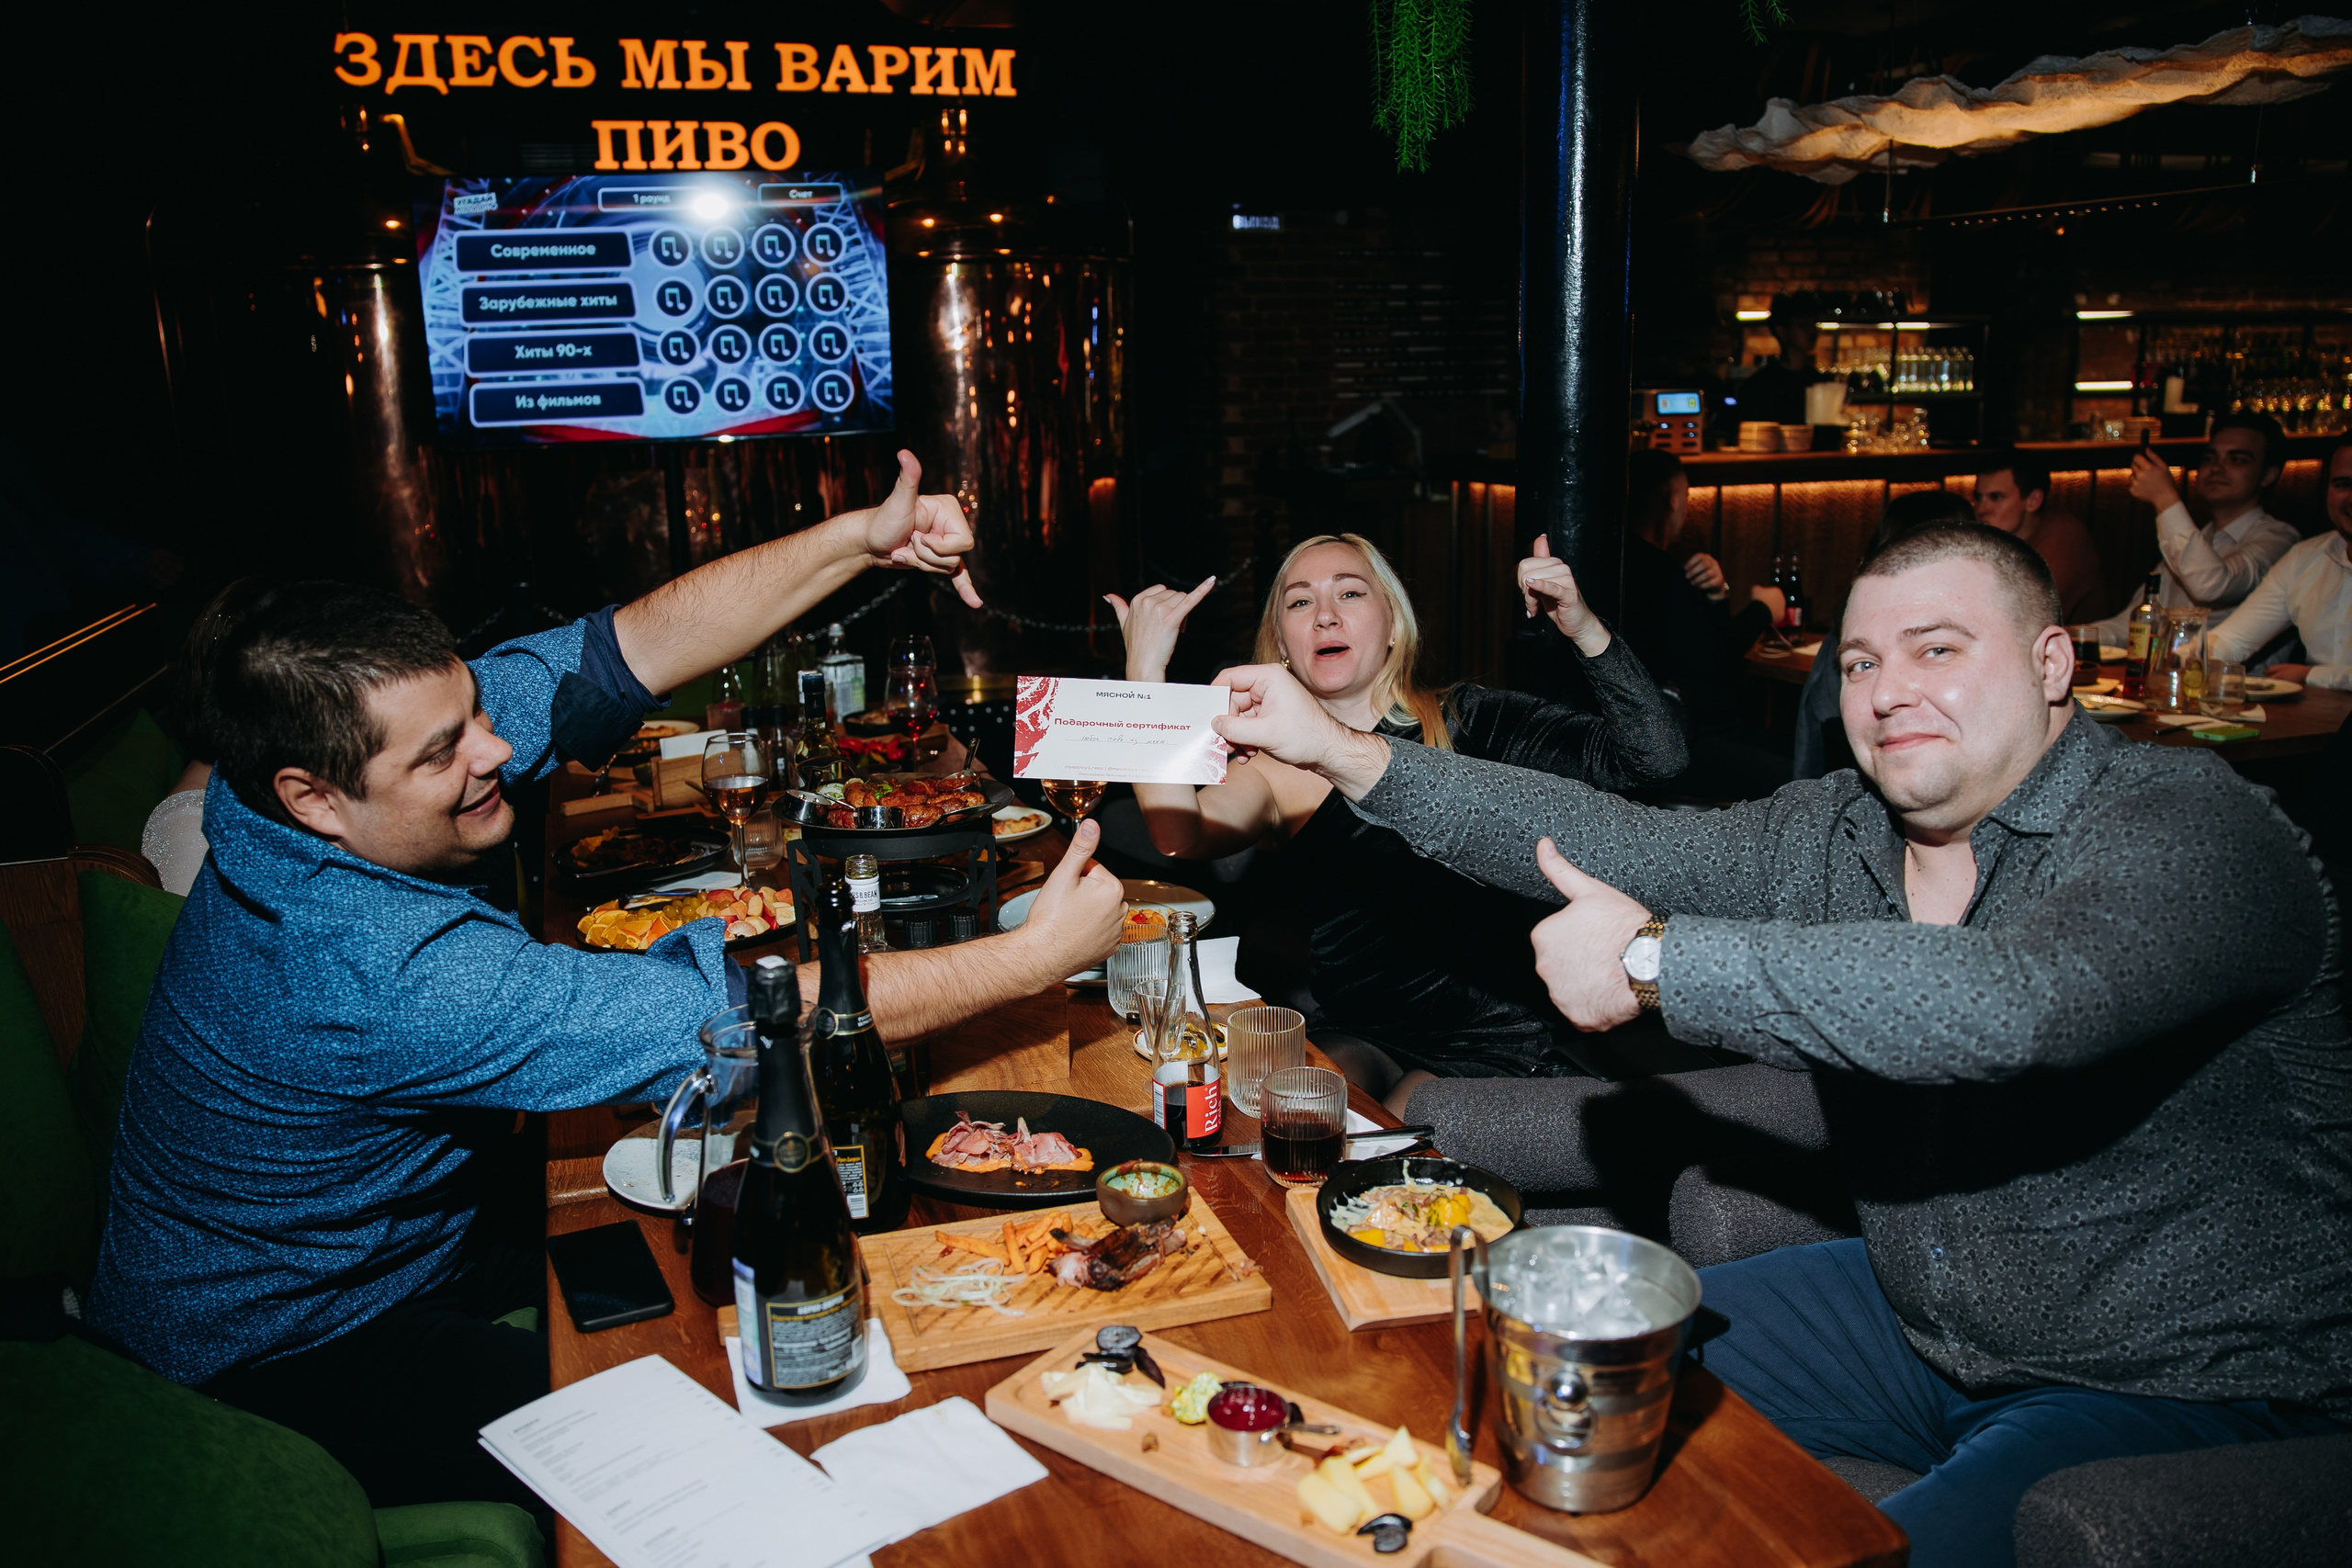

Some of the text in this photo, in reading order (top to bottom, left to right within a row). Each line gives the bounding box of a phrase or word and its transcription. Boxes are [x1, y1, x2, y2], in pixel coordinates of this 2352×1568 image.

[334, 32, 1016, 96] ЗДЕСЬ МЫ ВАРИМ
[591, 120, 801, 171] ПИВО
[490, 243, 597, 261] Современное
[478, 295, 618, 313] Зарубежные хиты
[514, 343, 594, 359] Хиты 90-х
[515, 393, 602, 411] Из фильмов
[1096, 691, 1135, 699] МЯСНОЙ
[1054, 717, 1192, 731] Подарочный сертификат
[1204, 1085, 1218, 1133] Rich
